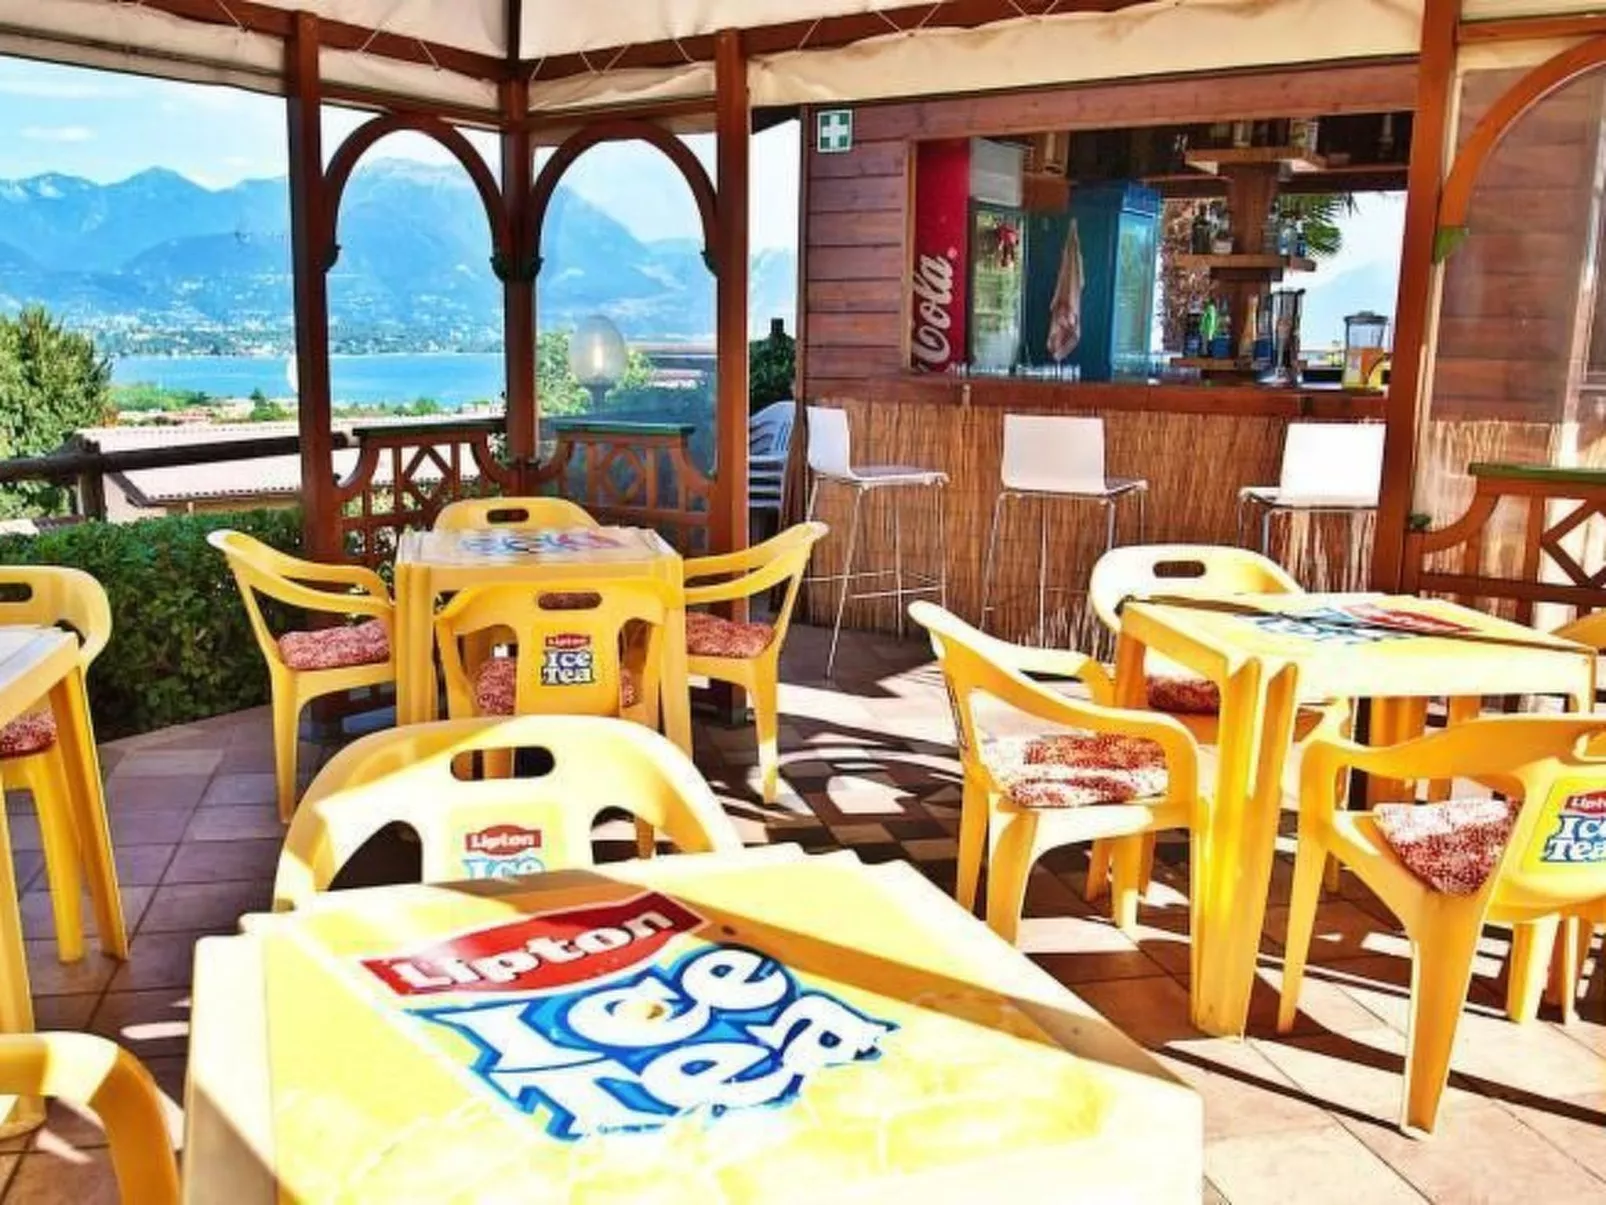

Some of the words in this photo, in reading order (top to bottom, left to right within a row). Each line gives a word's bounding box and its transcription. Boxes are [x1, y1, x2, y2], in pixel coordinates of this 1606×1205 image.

[912, 254, 953, 365] Cola
[542, 667, 592, 684] Tea
[545, 650, 592, 667] Ice
[392, 908, 675, 991] Lipton
[422, 944, 794, 1072] Ice
[488, 990, 892, 1138] Tea
